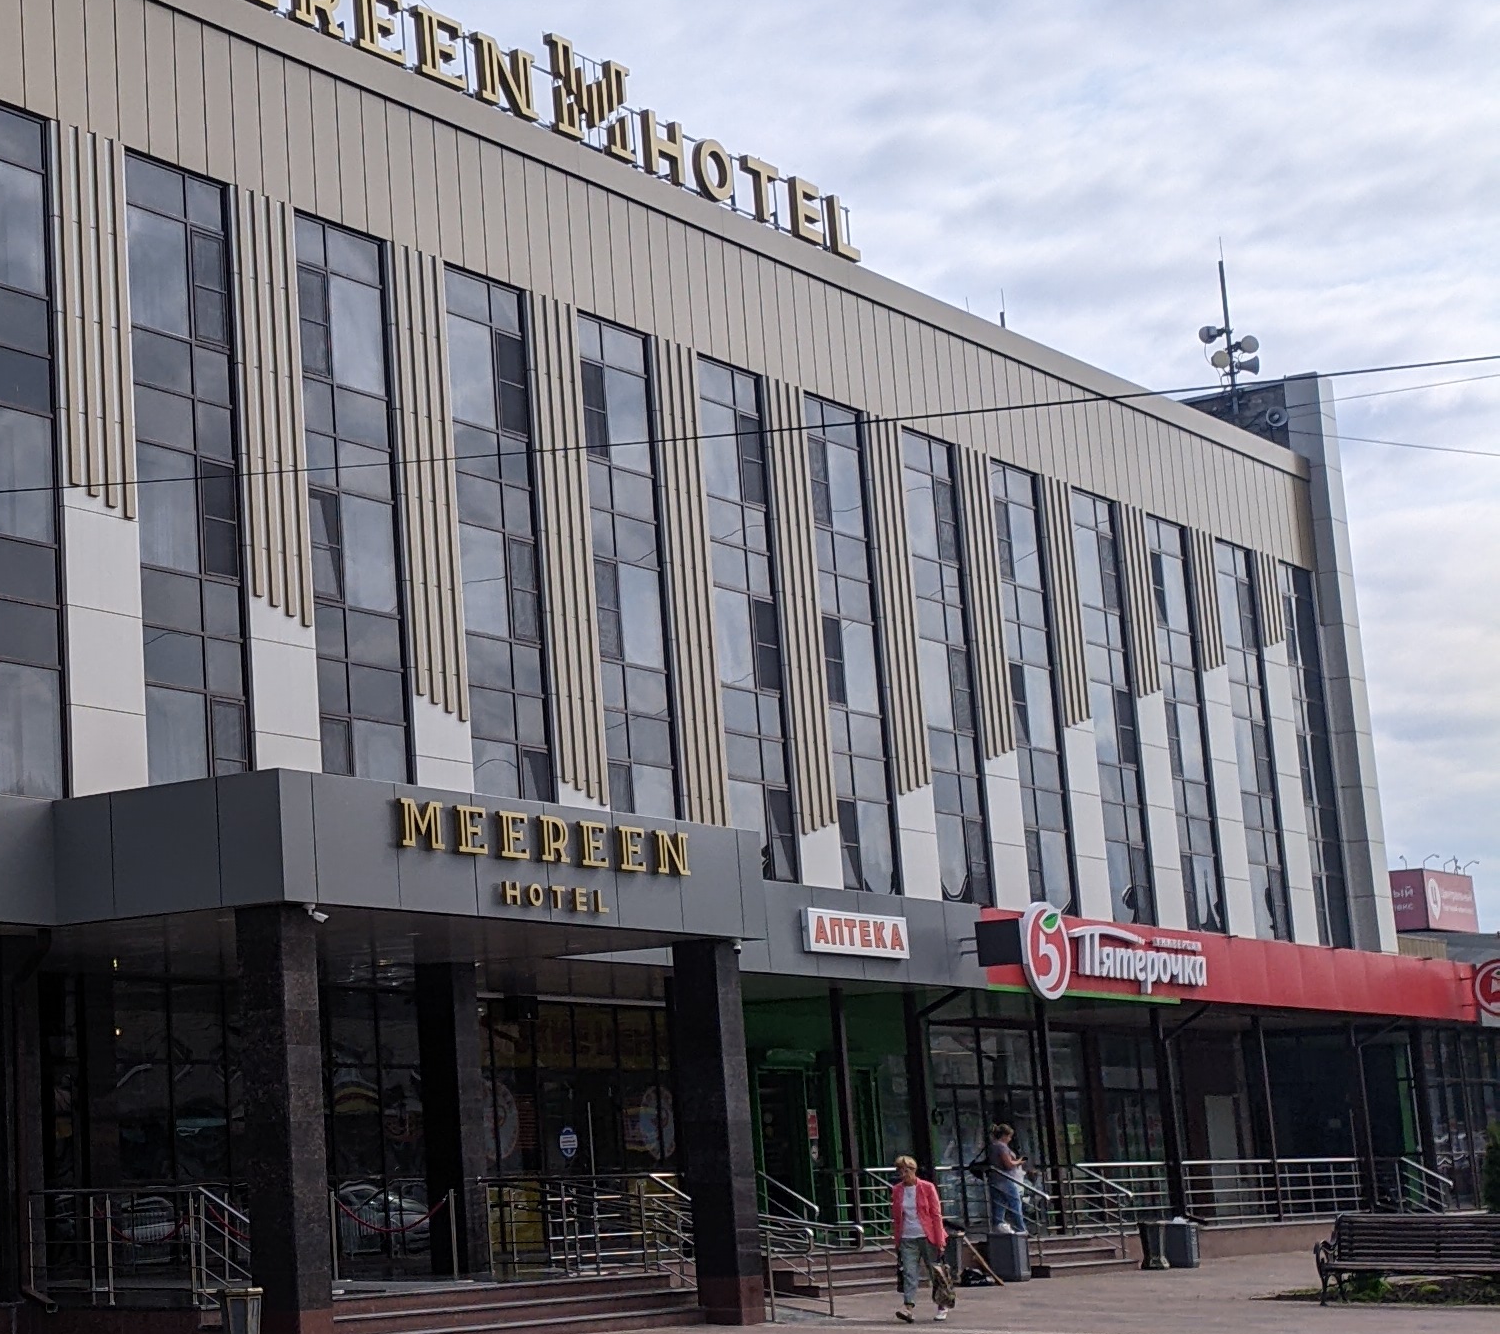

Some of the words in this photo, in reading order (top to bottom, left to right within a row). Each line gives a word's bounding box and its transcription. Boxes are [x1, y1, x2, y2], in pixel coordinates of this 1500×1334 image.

[641, 107, 861, 262] HOTEL
[398, 797, 691, 876] MEEREEN
[500, 880, 609, 913] HOTEL
[814, 915, 905, 951] АПТЕКА
[1068, 925, 1208, 995] Пятерочка
